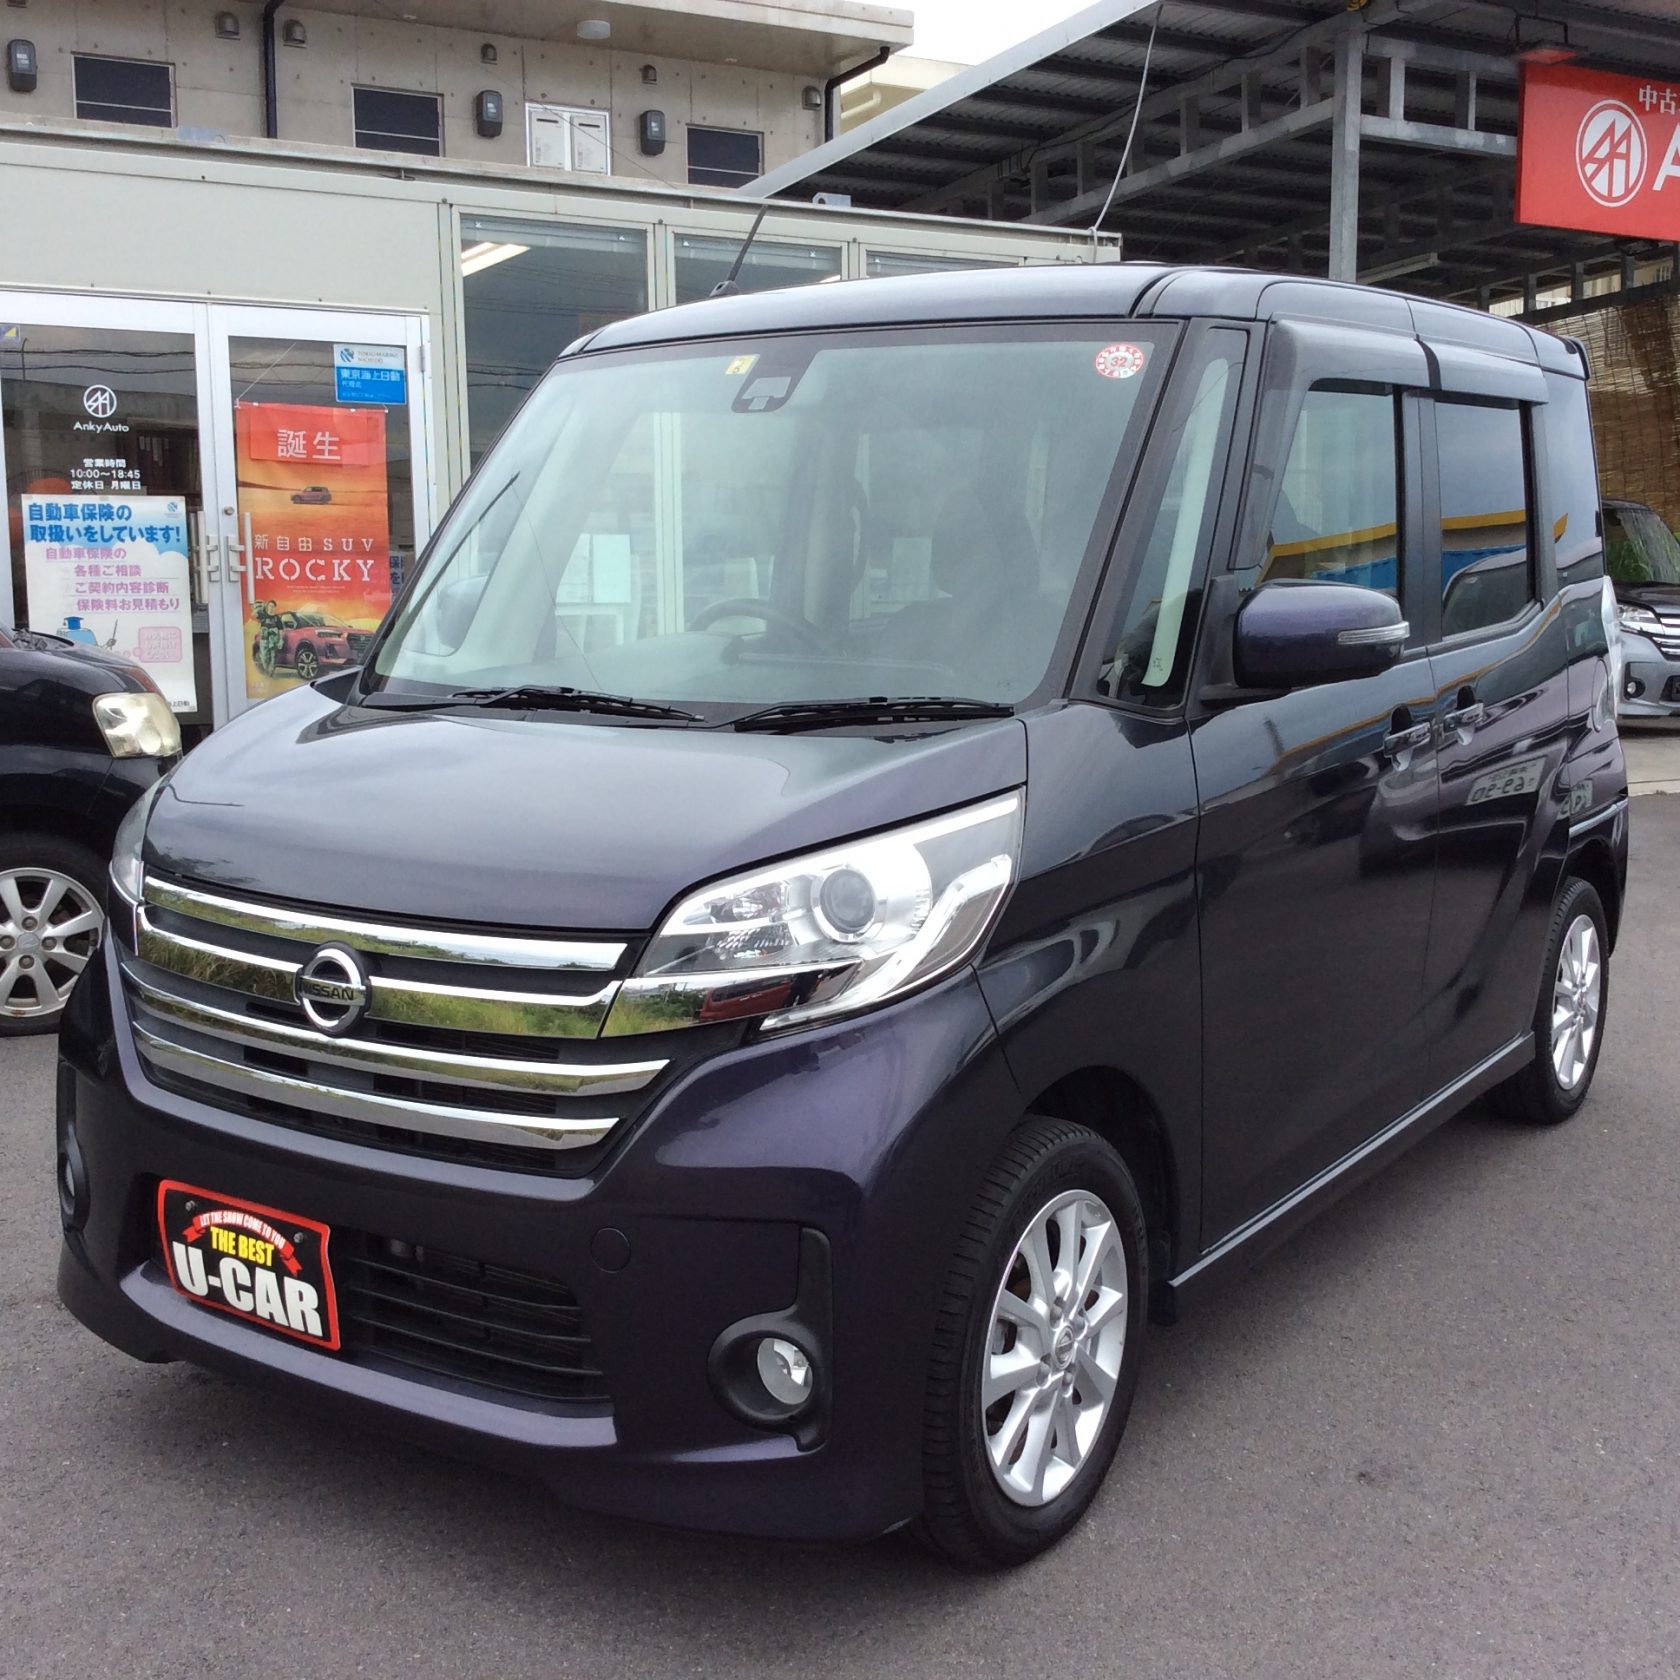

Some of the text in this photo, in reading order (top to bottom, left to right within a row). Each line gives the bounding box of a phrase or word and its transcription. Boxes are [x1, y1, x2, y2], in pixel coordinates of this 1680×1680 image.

[1638, 84, 1680, 116] 中古
[277, 429, 341, 460] 誕生
[83, 458, 126, 468] 営業時間
[71, 480, 141, 490] 定休日 月曜日
[28, 503, 132, 521] 自動車保険の
[46, 547, 127, 560] 自動車保険の
[74, 564, 142, 577] 各種ご相談
[255, 557, 375, 581] ROCKY
[75, 581, 169, 594] ご契約内容診断
[76, 598, 180, 611] 保険料お見積もり
[210, 1211, 223, 1224] THE
[210, 1226, 275, 1267] THE BEST
[172, 1241, 323, 1337] U-CAR
